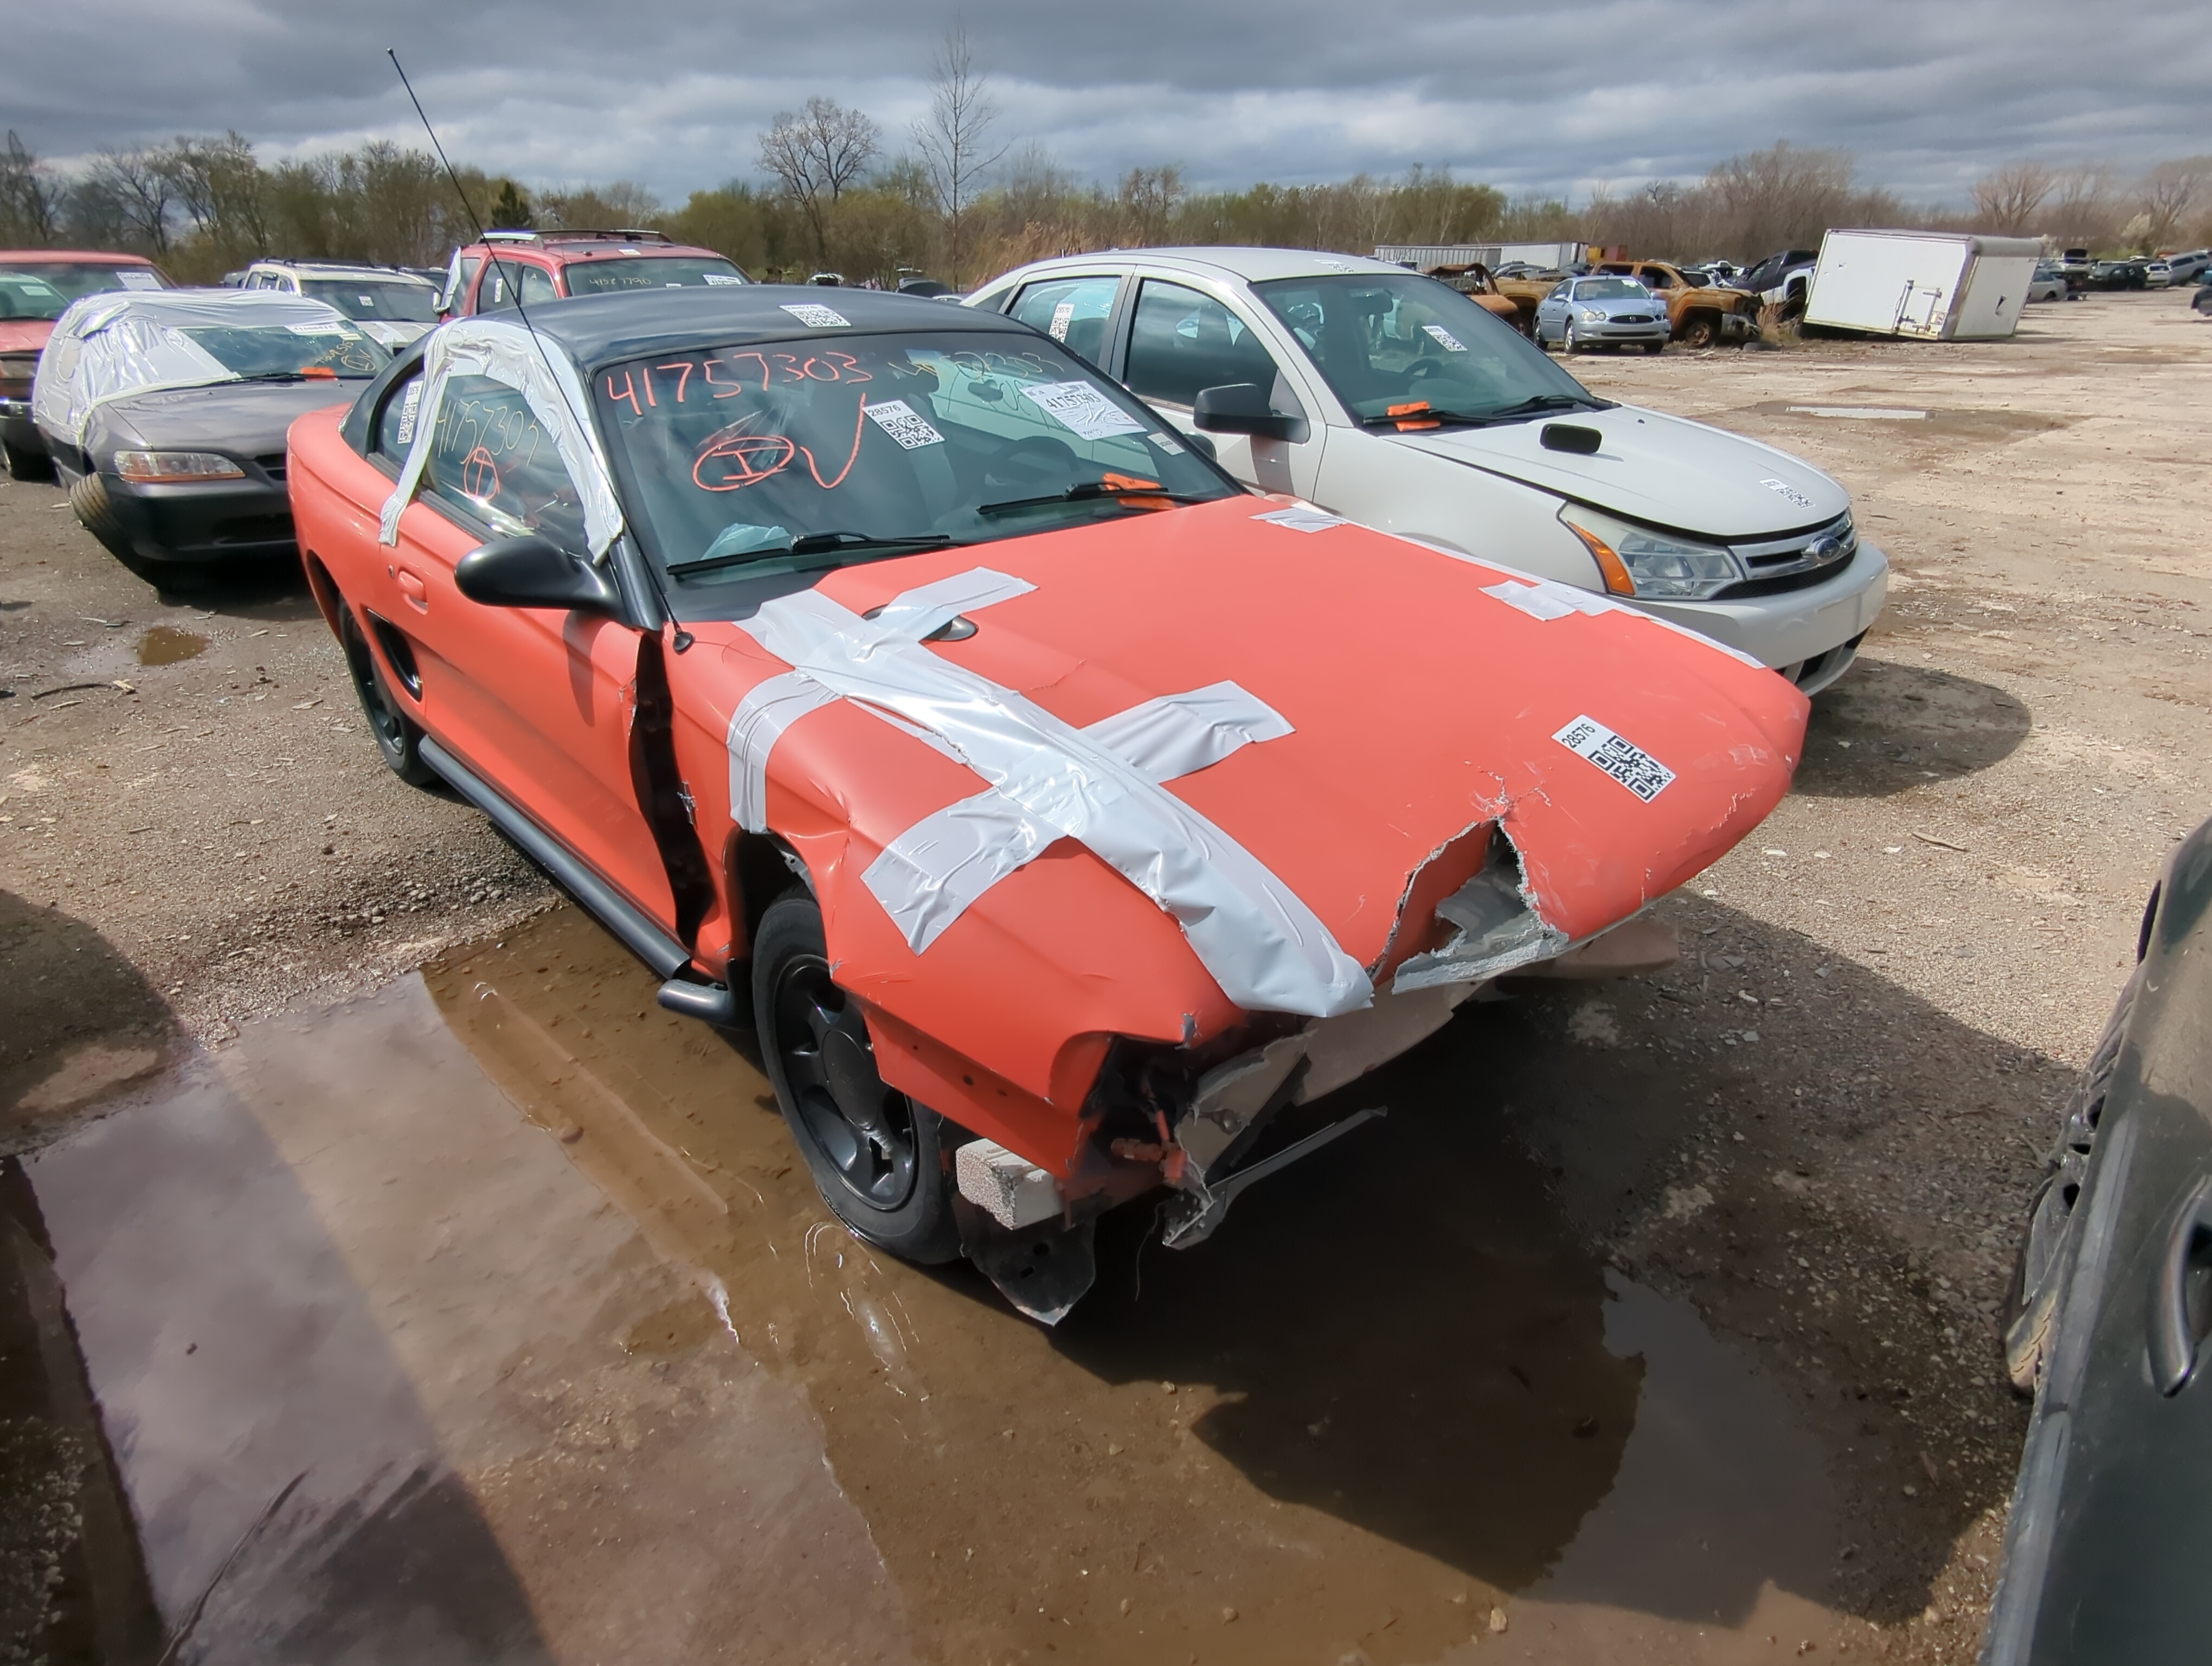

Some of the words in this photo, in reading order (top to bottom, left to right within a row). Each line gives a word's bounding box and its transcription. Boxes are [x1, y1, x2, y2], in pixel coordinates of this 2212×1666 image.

[607, 351, 873, 415] 41757303
[867, 405, 901, 416] 28576
[1045, 393, 1101, 408] 41757303
[1561, 723, 1596, 749] 28576
